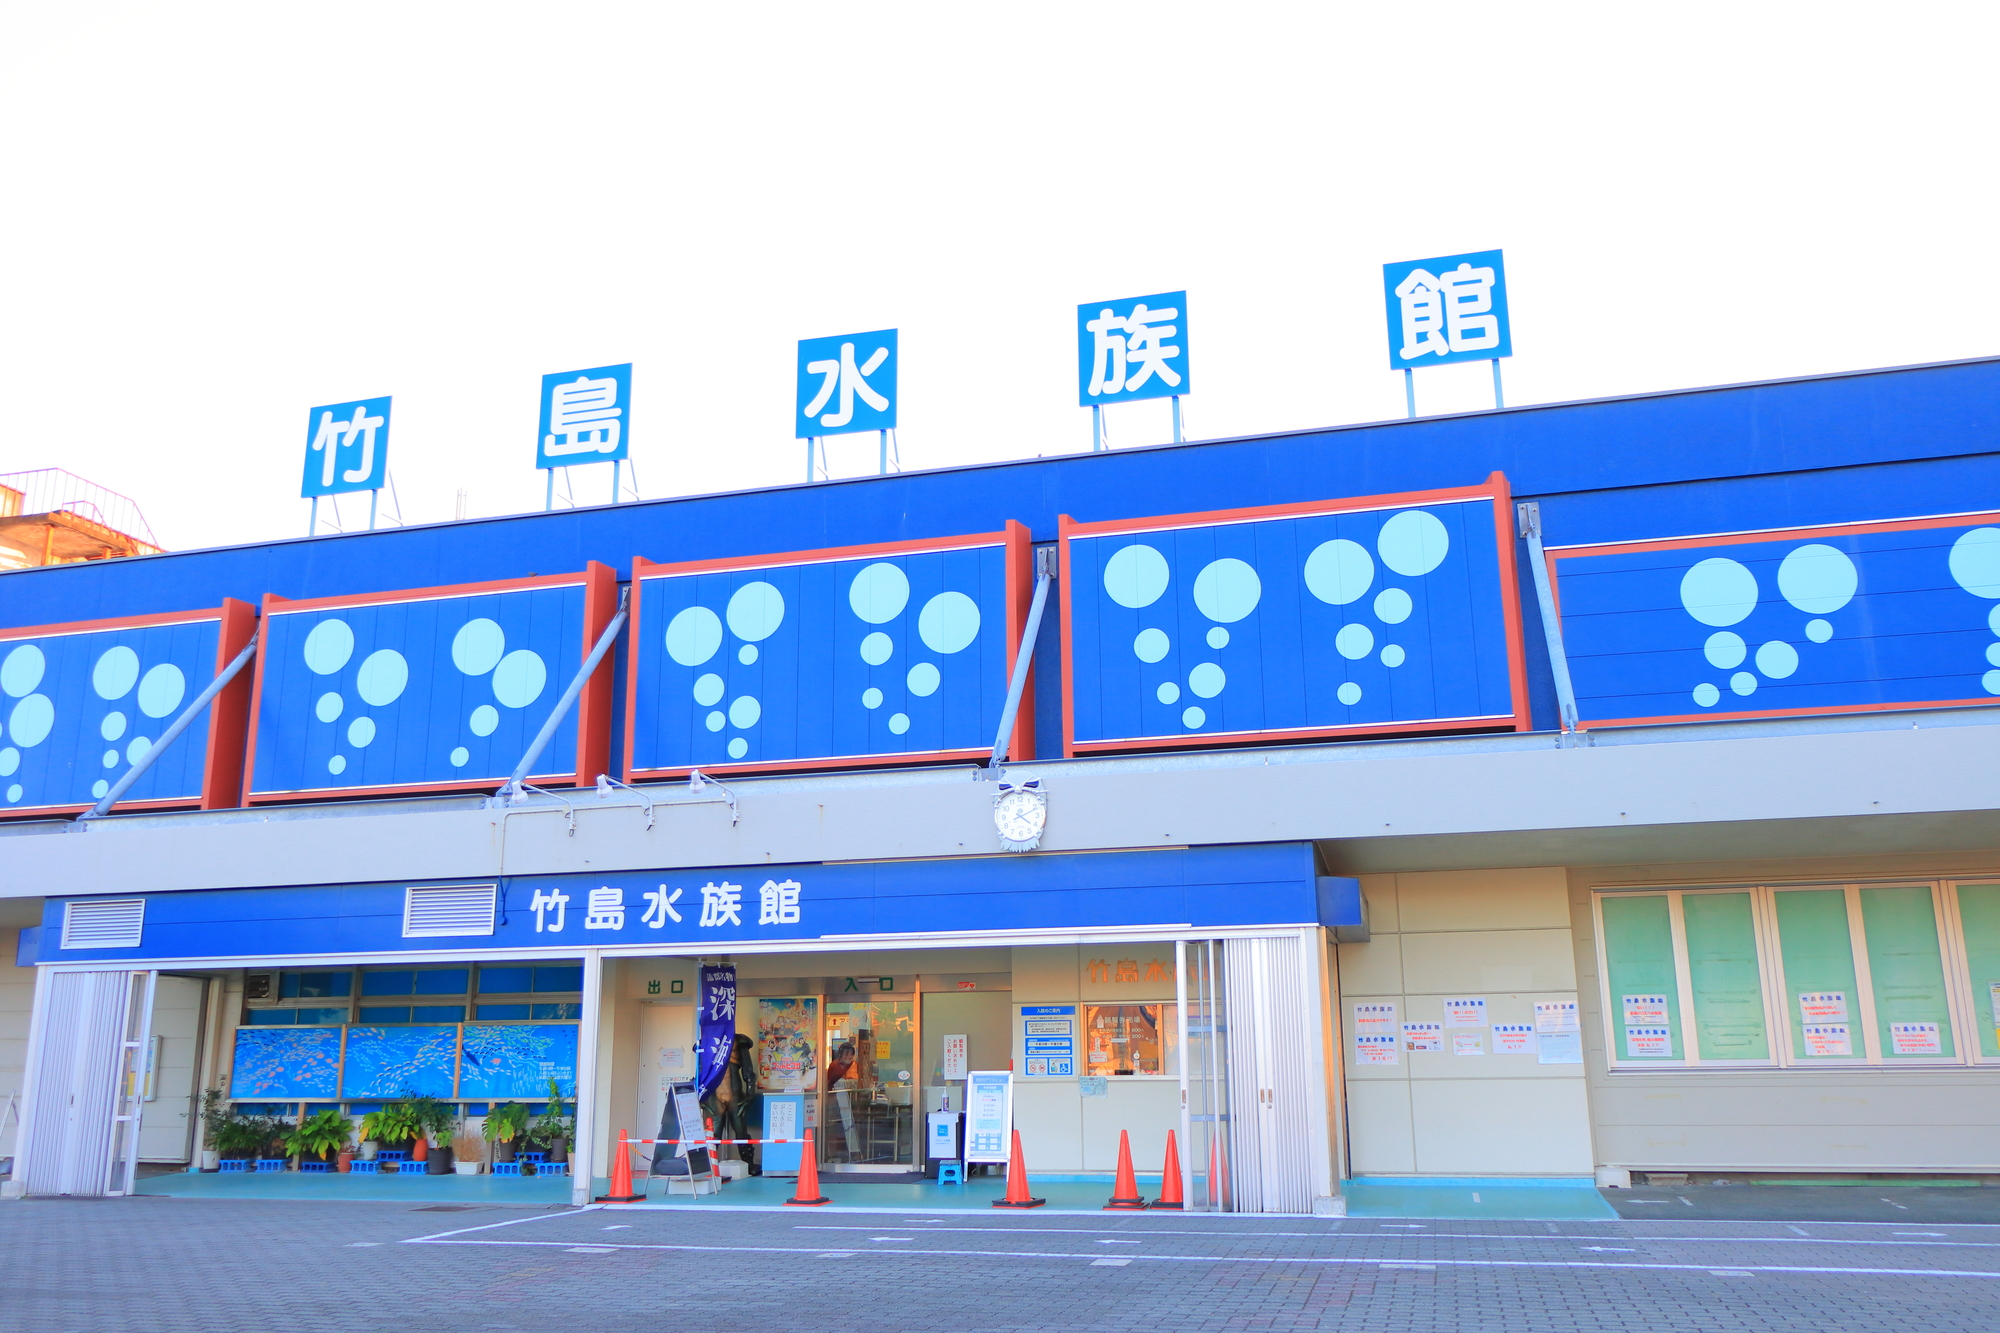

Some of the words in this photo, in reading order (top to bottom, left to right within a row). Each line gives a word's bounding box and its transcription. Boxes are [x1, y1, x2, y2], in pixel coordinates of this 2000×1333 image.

[530, 879, 802, 933] 竹島水族館
[648, 979, 684, 994] 出口
[844, 977, 894, 992] 入口
